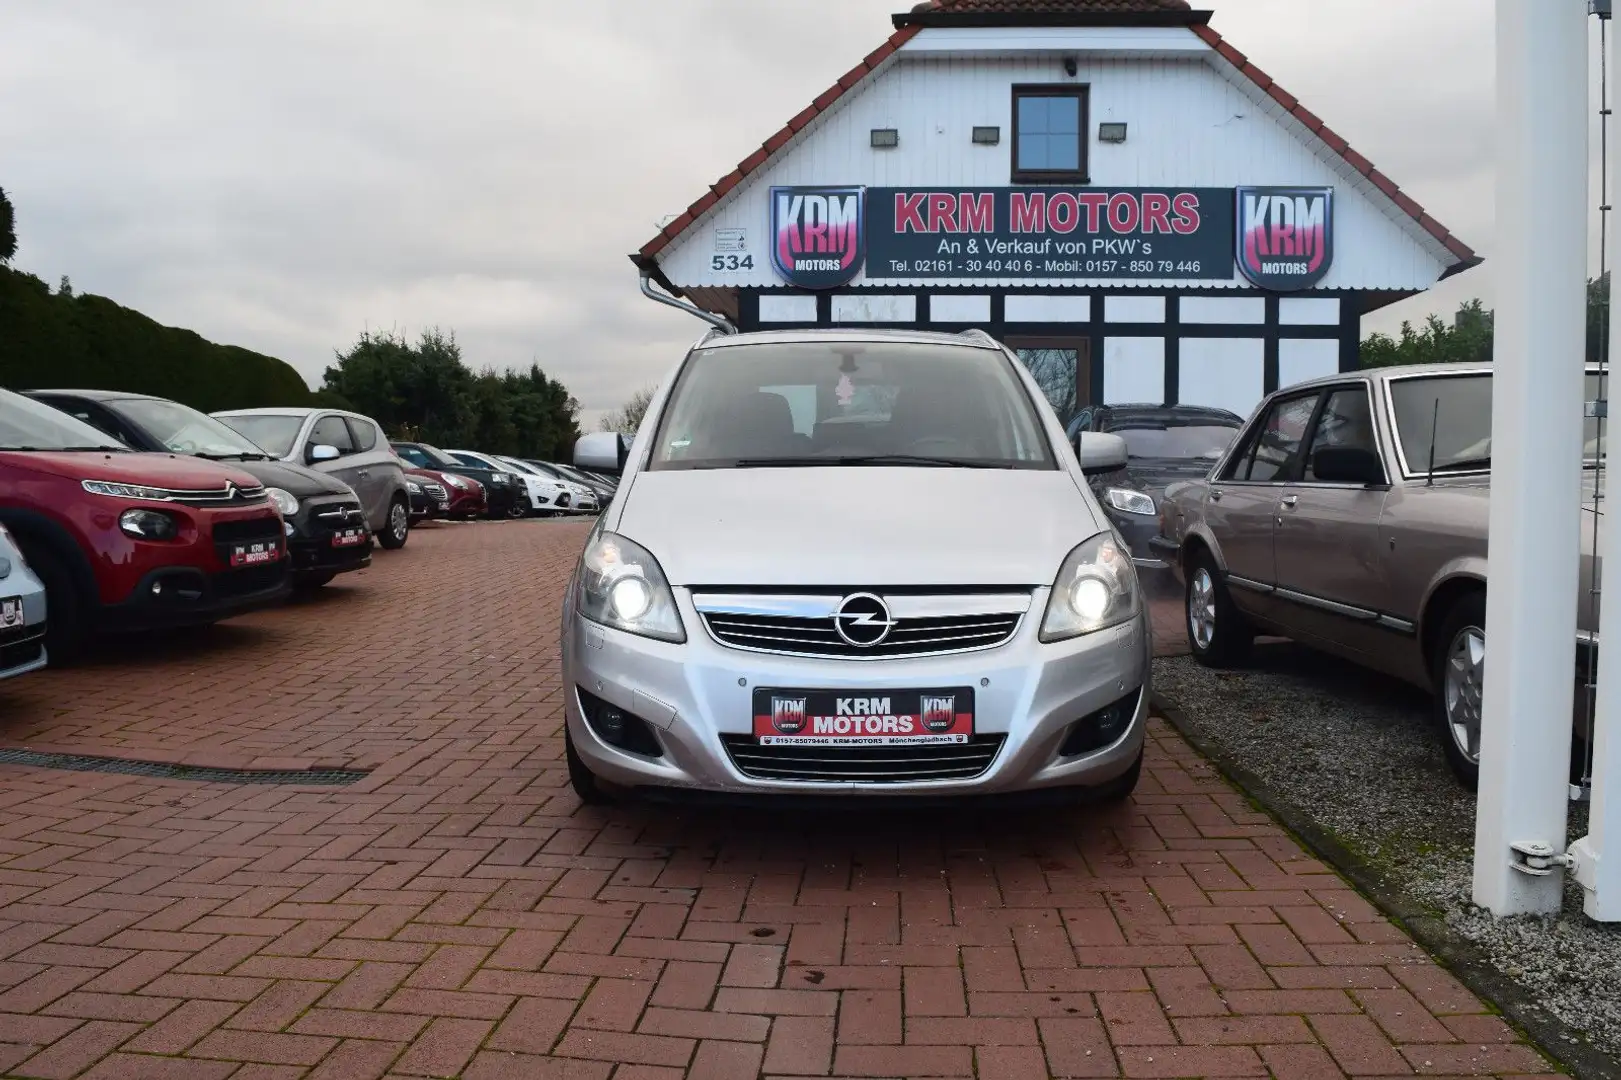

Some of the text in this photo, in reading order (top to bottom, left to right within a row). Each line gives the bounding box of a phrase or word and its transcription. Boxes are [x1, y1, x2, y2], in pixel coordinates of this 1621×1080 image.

[895, 192, 1200, 234] KRM MOTORS
[779, 195, 857, 256] KRM
[1245, 195, 1324, 260] KRM
[937, 238, 961, 254] An
[966, 238, 979, 254] &
[985, 238, 1052, 254] Verkauf
[1055, 242, 1087, 255] von
[712, 254, 754, 271] 534
[795, 259, 841, 271] MOTORS
[889, 260, 911, 272] Tel.
[914, 260, 953, 272] 02161
[966, 260, 982, 272] 30
[985, 260, 1001, 272] 40
[1004, 260, 1021, 272] 40
[1024, 260, 1033, 272] 6
[1045, 260, 1083, 272] Mobil:
[1086, 260, 1118, 272] 0157
[1129, 260, 1154, 272] 850
[1157, 260, 1173, 273] 79
[1176, 260, 1201, 273] 446
[1262, 262, 1308, 275] MOTORS
[246, 551, 269, 563] MOTORS
[251, 543, 264, 553] KRM
[774, 699, 804, 722] KRM
[836, 697, 891, 716] KRM
[923, 698, 953, 720] KRM
[813, 715, 914, 734] MOTORS
